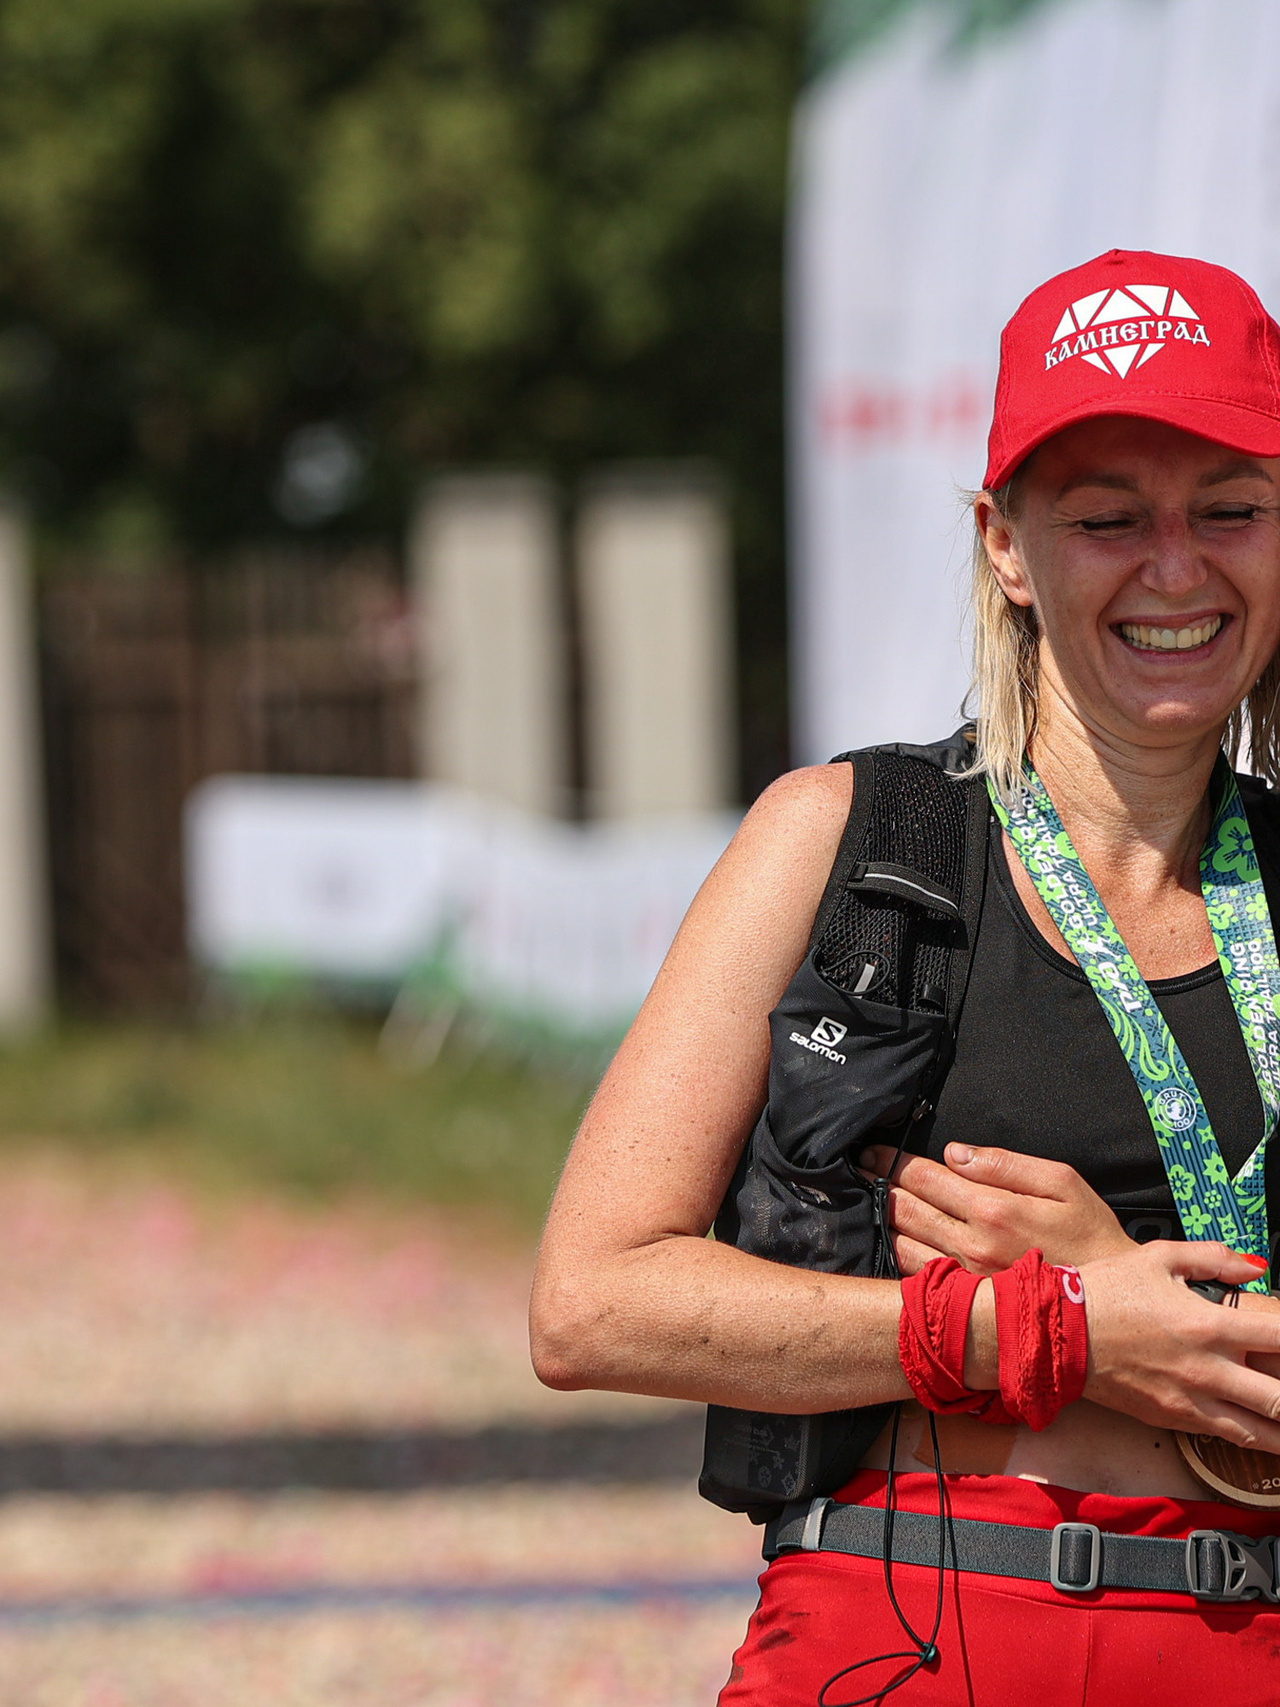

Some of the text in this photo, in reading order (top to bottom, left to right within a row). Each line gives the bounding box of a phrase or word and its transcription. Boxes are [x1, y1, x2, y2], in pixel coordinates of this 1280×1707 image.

[1034, 815, 1067, 869] TRAIL
[1029, 845, 1083, 929] GOLDEN
[1062, 870, 1098, 926] ULTRA
[1247, 940, 1265, 970] 100
[1230, 942, 1273, 1085] GOLDEN RING
[1256, 973, 1277, 1025] TRAIL
[1174, 1117, 1190, 1128] 100
